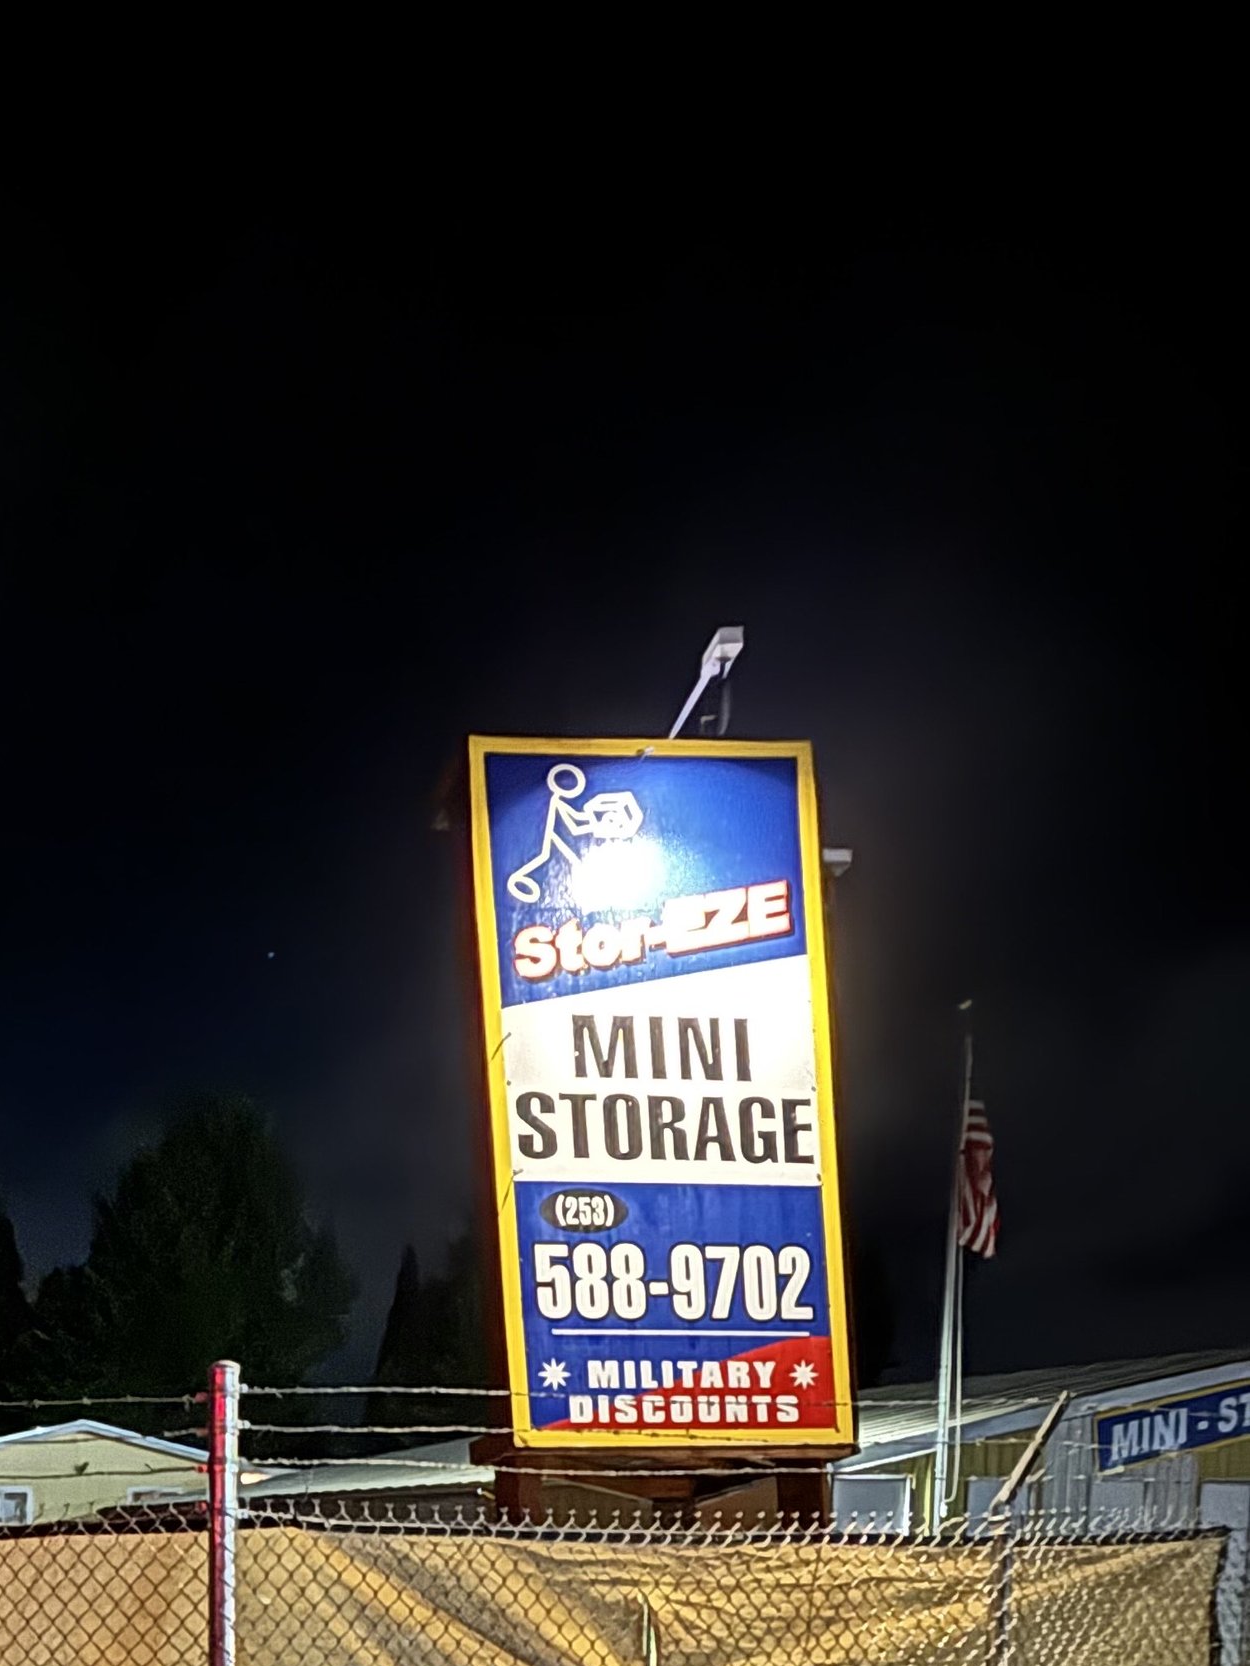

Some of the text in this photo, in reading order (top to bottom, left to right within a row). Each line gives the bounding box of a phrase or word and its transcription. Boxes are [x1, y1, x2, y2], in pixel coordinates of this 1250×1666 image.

[572, 1014, 751, 1081] MINI
[515, 1091, 815, 1164] STORAGE
[554, 1196, 615, 1227] (253)
[532, 1242, 814, 1321] 588-9702
[587, 1360, 776, 1389] MILITARY
[569, 1395, 800, 1424] DISCOUNTS
